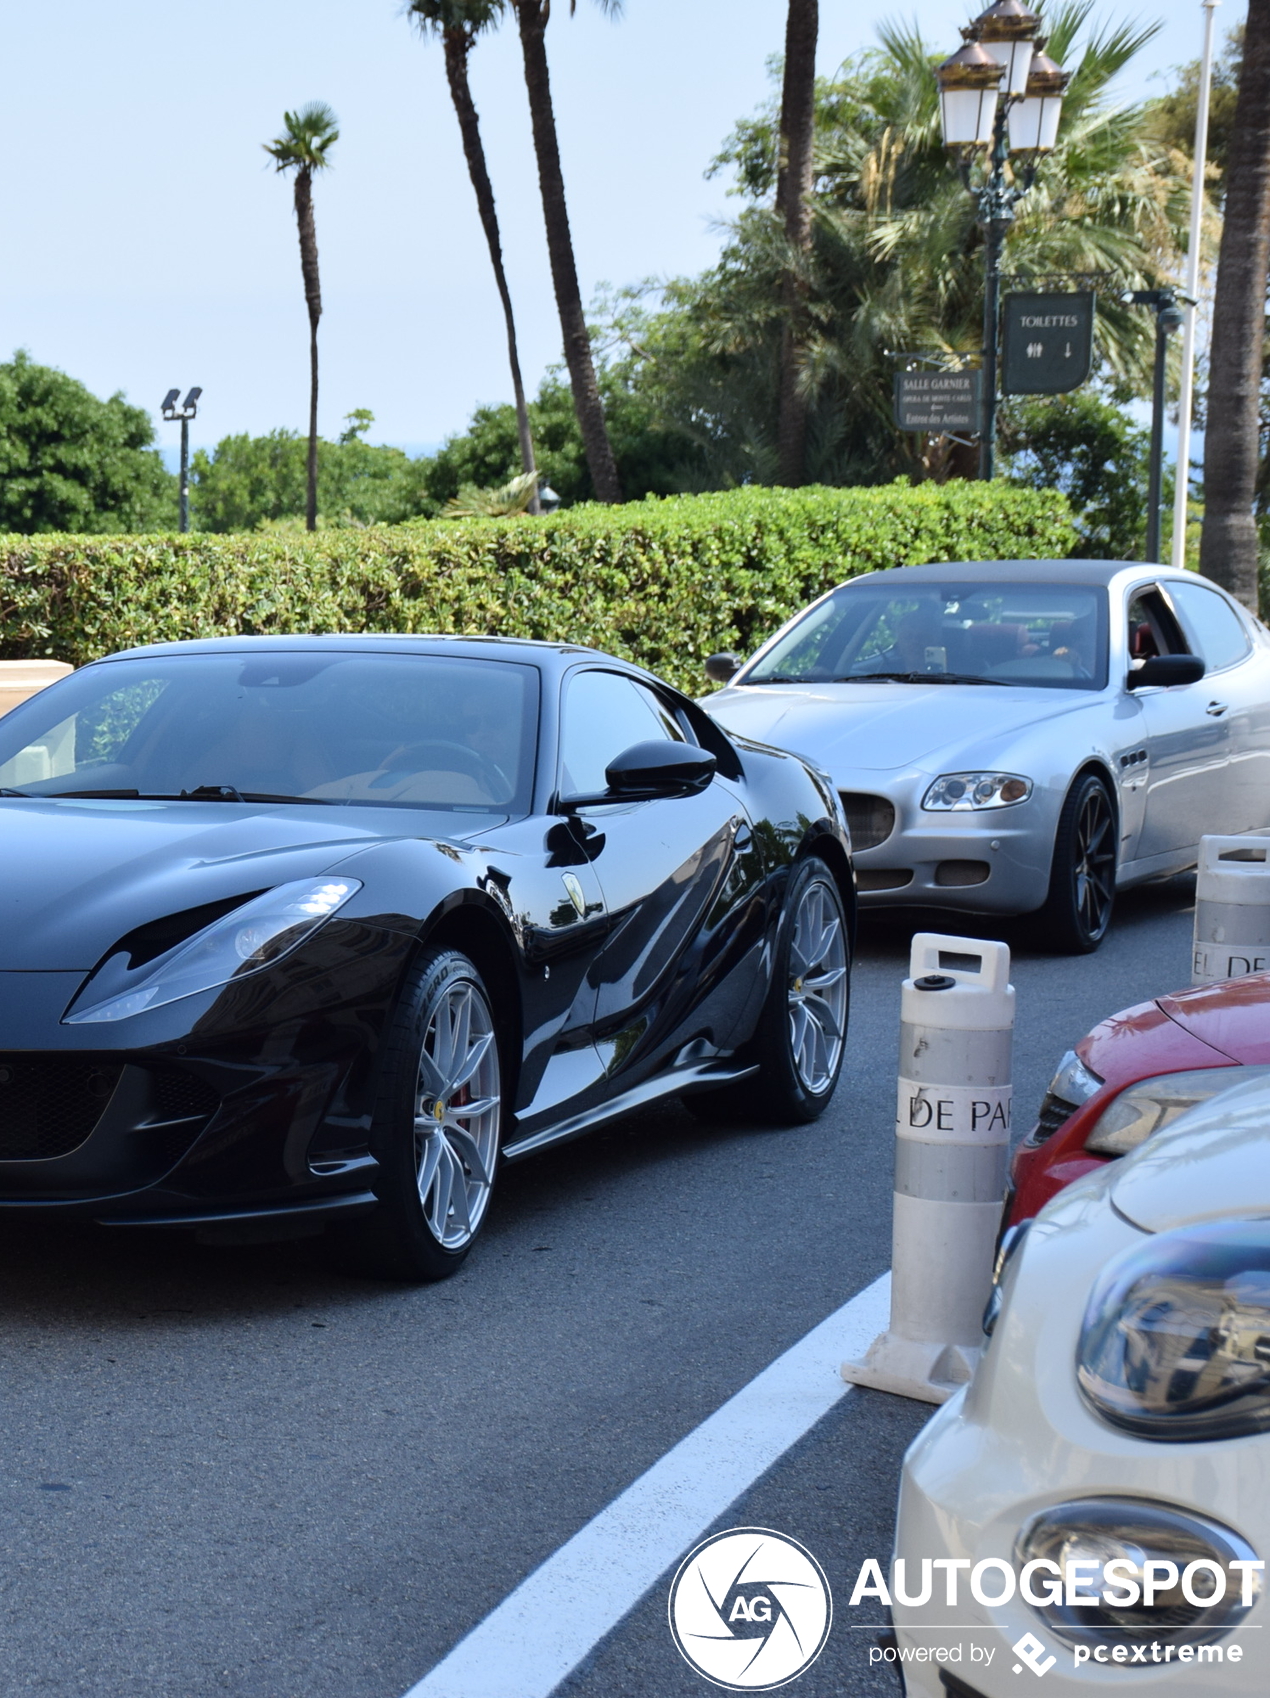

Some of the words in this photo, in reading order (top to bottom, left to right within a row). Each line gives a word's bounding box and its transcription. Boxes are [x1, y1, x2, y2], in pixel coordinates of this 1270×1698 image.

[1020, 315, 1078, 328] TOILETTES
[903, 378, 930, 391] SALLE
[931, 378, 970, 390] GARNIER
[929, 412, 941, 424] des
[942, 413, 969, 424] Artistes
[910, 1096, 954, 1131] DE
